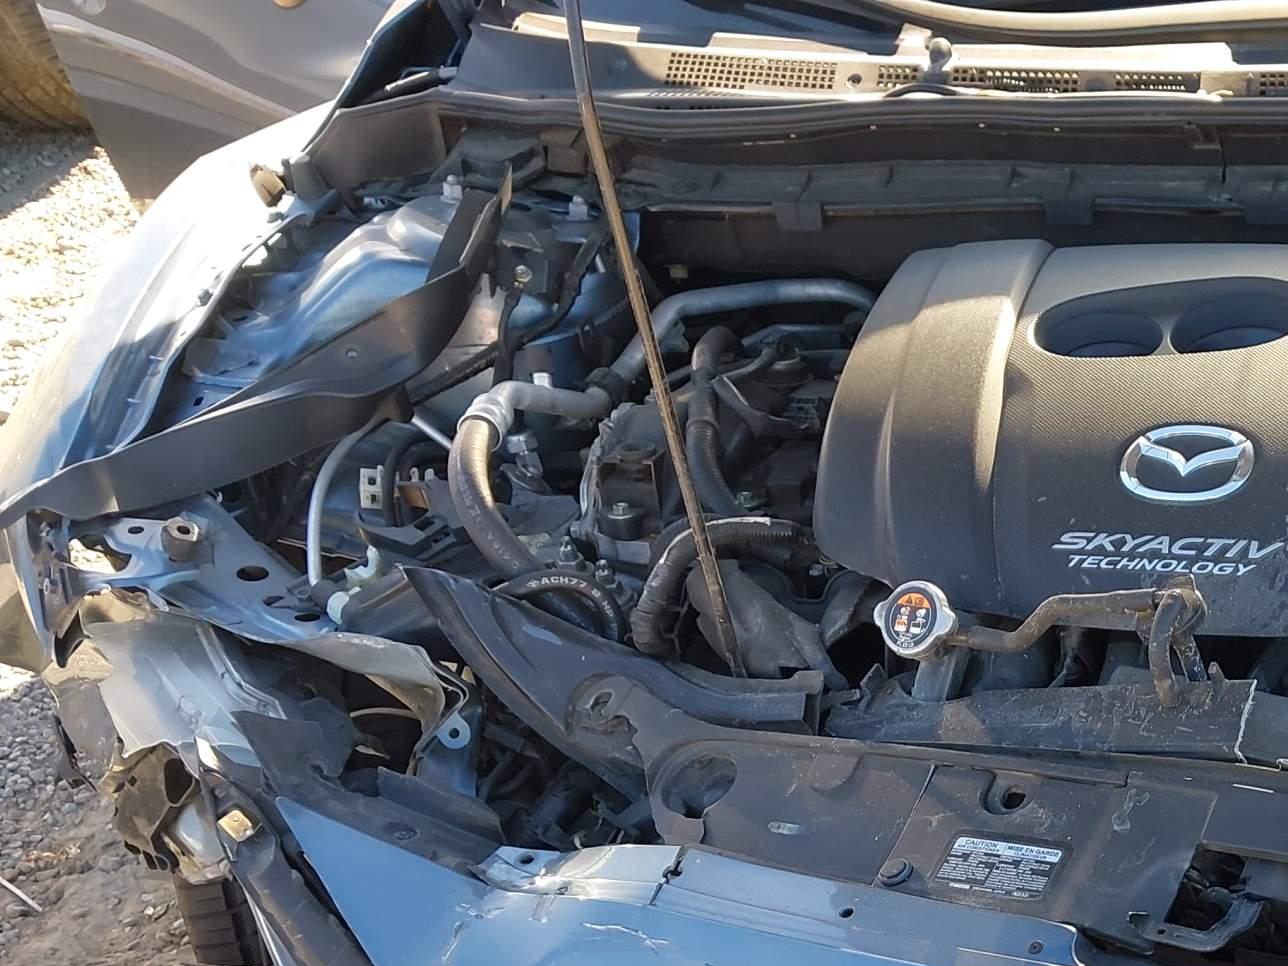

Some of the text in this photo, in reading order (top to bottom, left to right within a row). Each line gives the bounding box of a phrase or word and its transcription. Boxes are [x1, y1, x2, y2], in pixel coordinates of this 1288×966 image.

[1051, 531, 1285, 559] SKYACTIV
[1067, 554, 1257, 576] TECHNOLOGY
[965, 839, 999, 848] CAUTION
[1007, 845, 1023, 853] MISE
[1035, 849, 1060, 857] GARDE
